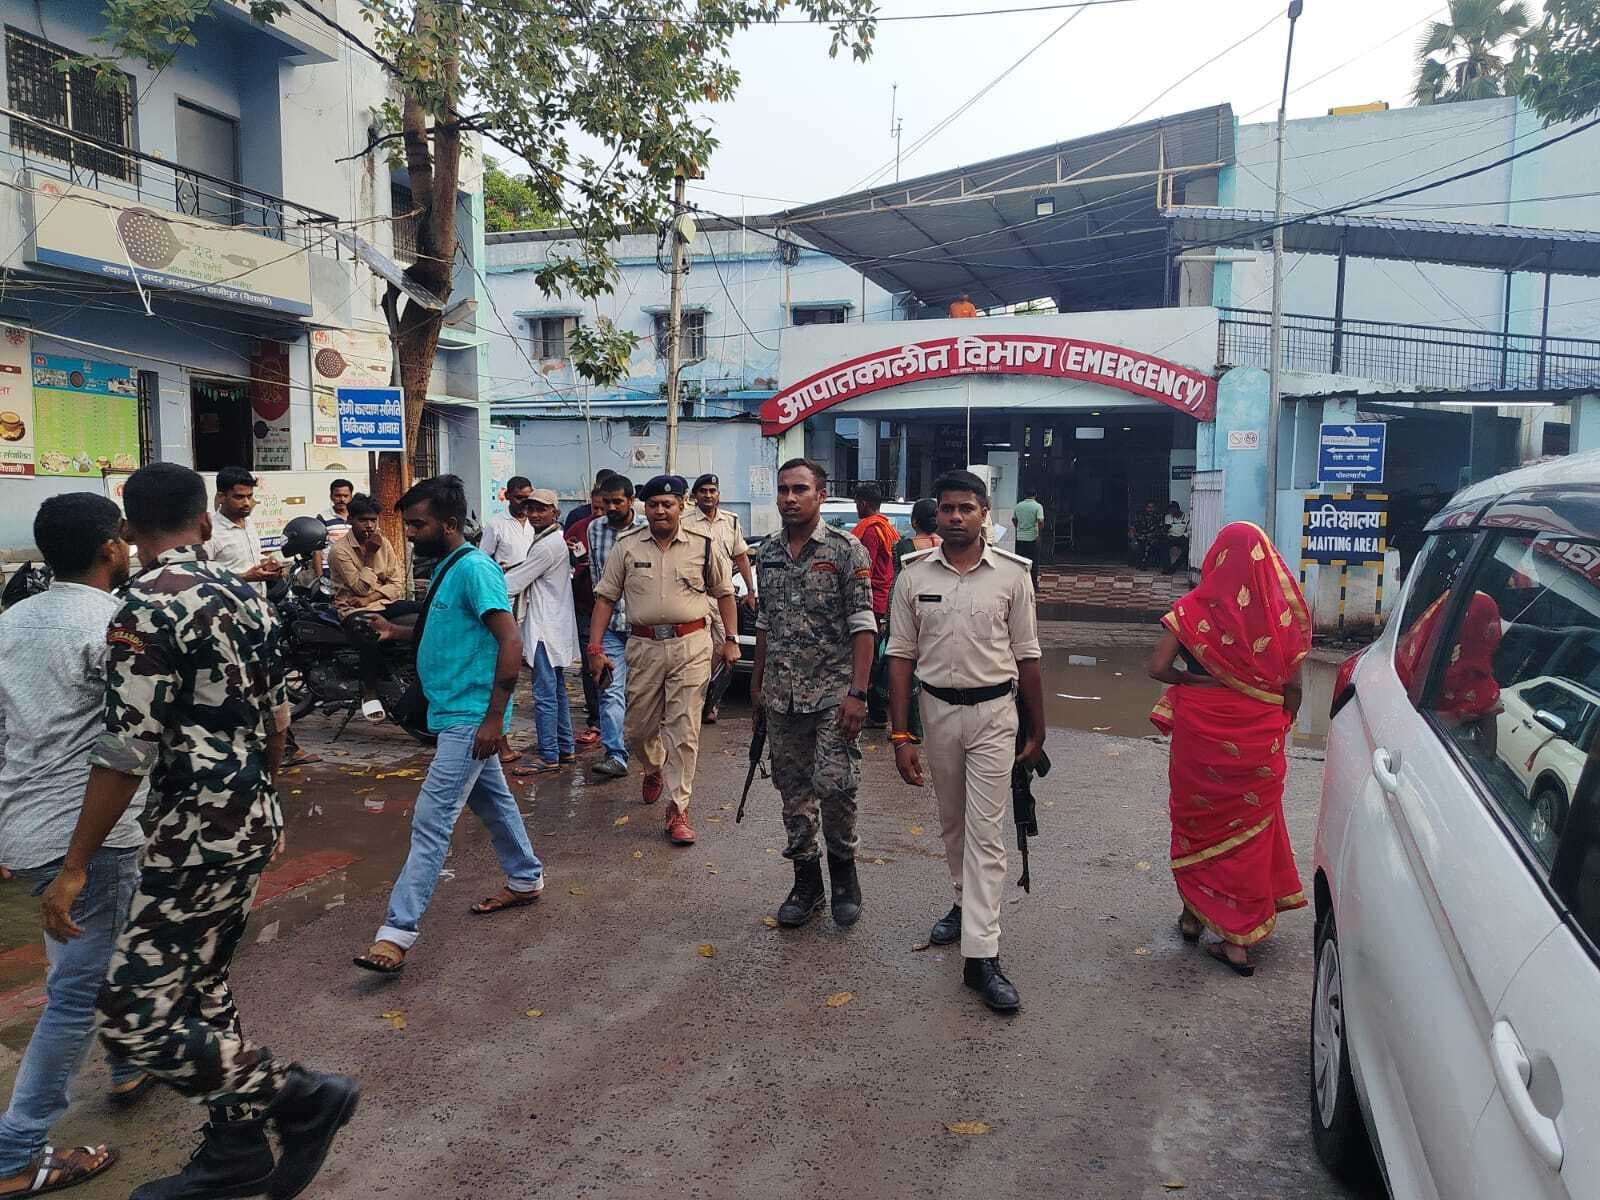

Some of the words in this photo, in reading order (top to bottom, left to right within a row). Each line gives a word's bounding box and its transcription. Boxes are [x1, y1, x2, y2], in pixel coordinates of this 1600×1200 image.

[778, 344, 951, 424] आपातकालीन
[956, 336, 1057, 368] विभाग
[1059, 341, 1206, 412] (EMERGENCY)
[1309, 503, 1381, 530] प्रतिक्षालय
[1307, 535, 1352, 552] WAITING
[1353, 537, 1379, 553] AREA
